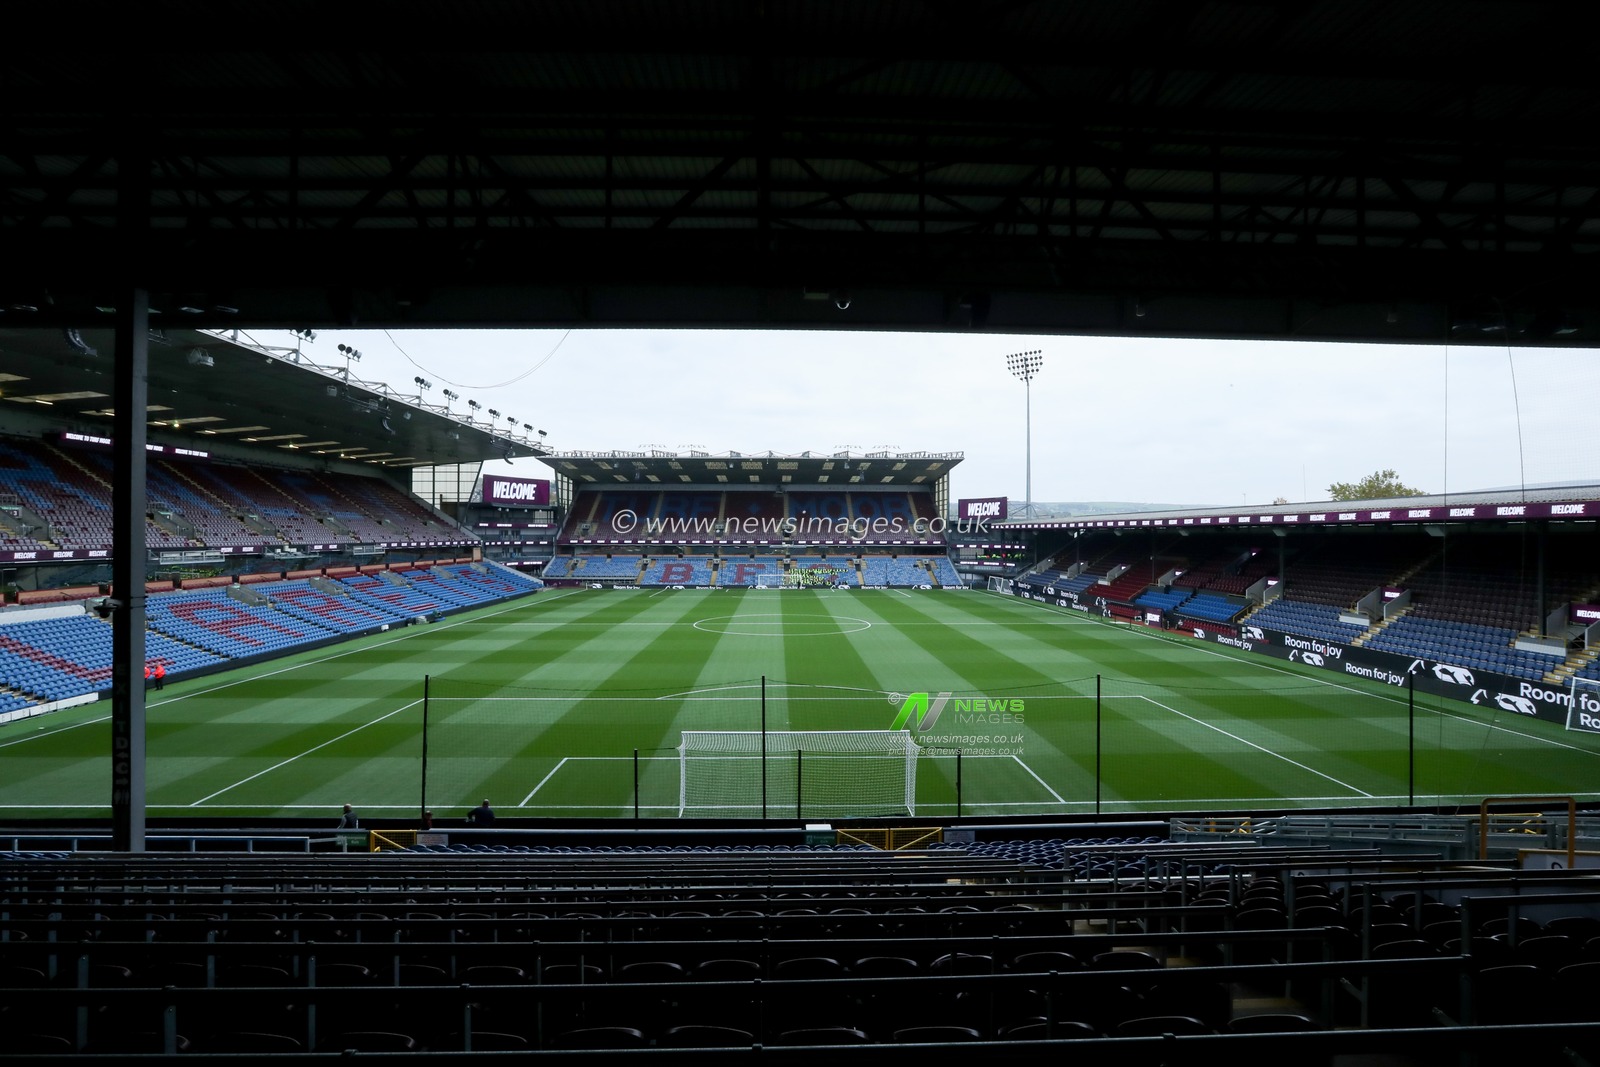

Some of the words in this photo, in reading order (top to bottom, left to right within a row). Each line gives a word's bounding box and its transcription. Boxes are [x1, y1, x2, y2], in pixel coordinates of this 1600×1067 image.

[493, 480, 537, 501] WELCOME
[968, 501, 1000, 517] WELCOME
[1371, 511, 1391, 520] WELCOME
[1408, 509, 1431, 518] WELCOME
[1450, 507, 1475, 517] WELCOME
[1497, 506, 1526, 515] WELCOME
[1551, 504, 1585, 514] WELCOME
[1217, 634, 1233, 645] Room
[1234, 637, 1242, 647] for
[1242, 639, 1252, 651] joy
[1285, 635, 1311, 651] Room
[1312, 640, 1325, 653] for
[1325, 642, 1342, 659] joy
[1346, 662, 1372, 678] Room
[1373, 665, 1387, 681] for
[1387, 670, 1404, 686] joy
[1520, 682, 1575, 708] Room
